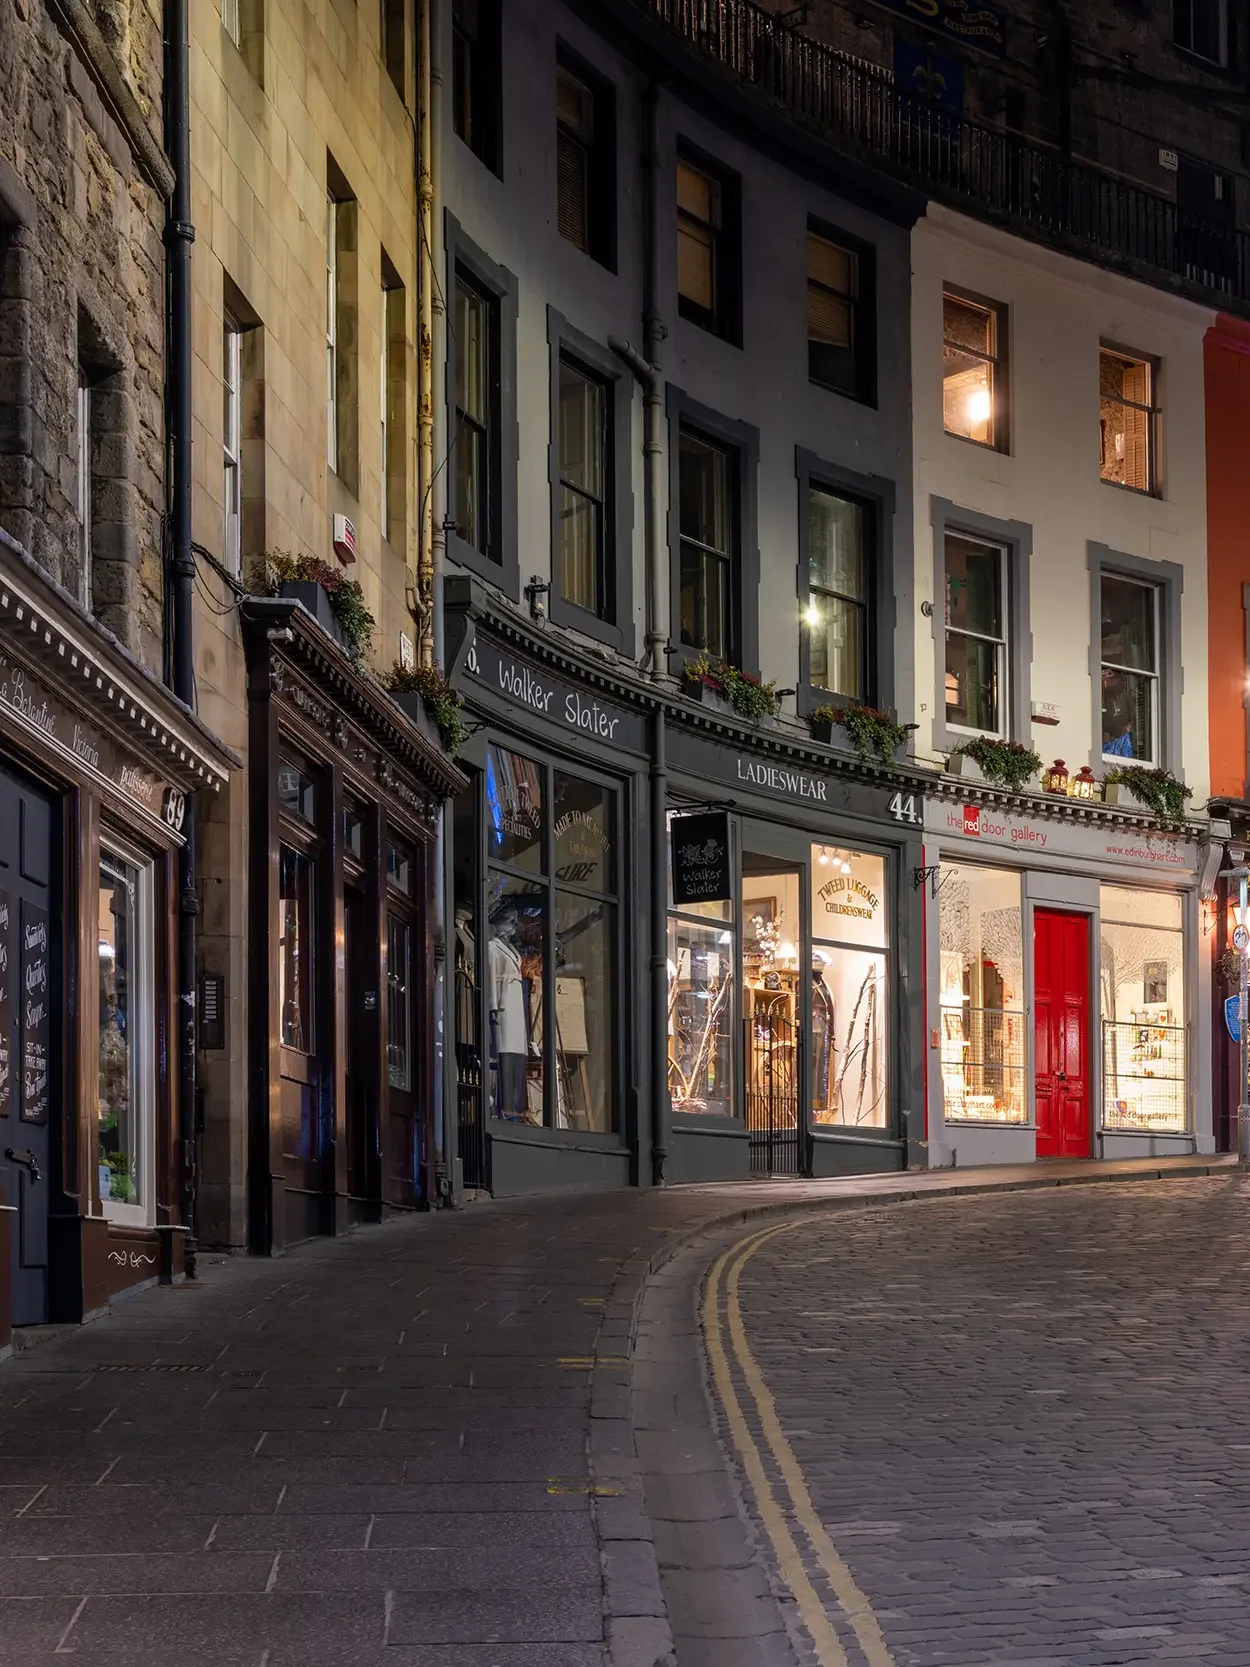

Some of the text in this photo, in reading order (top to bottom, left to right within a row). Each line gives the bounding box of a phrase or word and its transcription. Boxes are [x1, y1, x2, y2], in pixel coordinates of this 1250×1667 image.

[499, 660, 619, 739] Walker Slater
[73, 724, 99, 767] Victoria
[737, 759, 827, 801] LADIESWEAR
[167, 788, 185, 831] 89
[553, 811, 571, 840] MADE
[571, 809, 582, 826] TO
[501, 819, 532, 840] PECIALITIES
[946, 812, 1047, 846] the red door gallery
[1106, 846, 1185, 863] www.edinburghart.com
[817, 877, 880, 912] TWEED LUGGAGE
[825, 902, 873, 920] CHILDRENSWEAR
[846, 893, 853, 903] &
